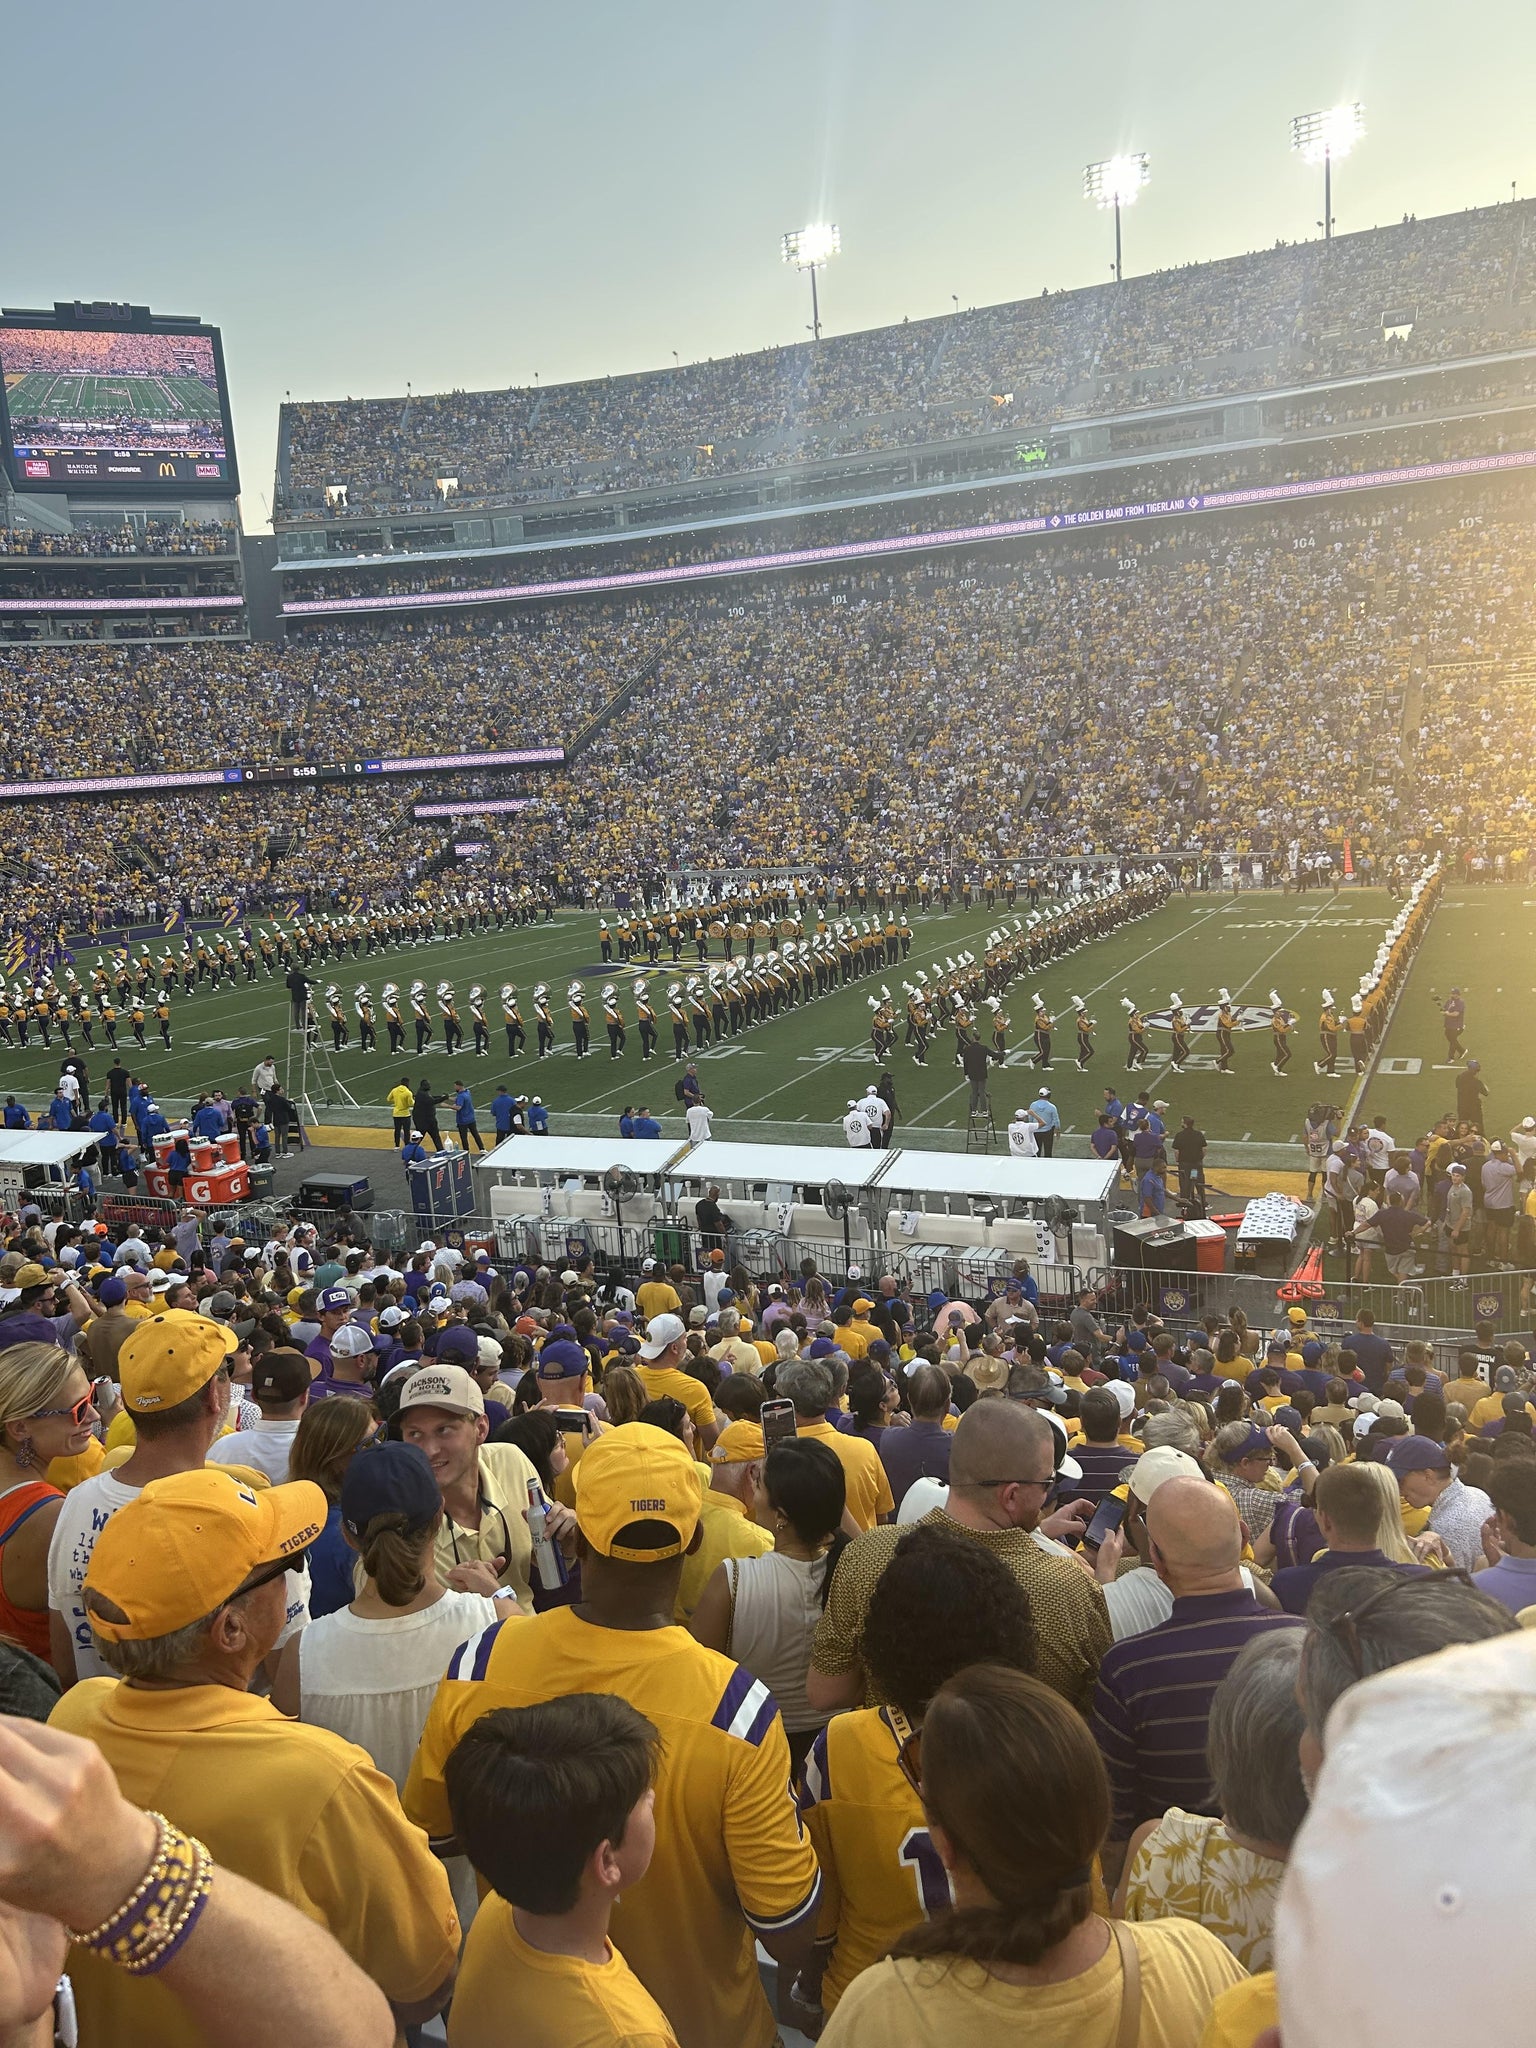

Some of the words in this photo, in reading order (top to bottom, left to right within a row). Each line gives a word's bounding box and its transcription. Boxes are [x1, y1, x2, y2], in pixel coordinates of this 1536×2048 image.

[74, 300, 132, 321] LSU
[1064, 514, 1076, 525] THE
[1078, 510, 1104, 523] GOLDEN
[1105, 507, 1124, 519] BAND
[1125, 504, 1145, 517] FROM
[1146, 499, 1185, 514] TIGERLAND
[1292, 537, 1316, 549] 104
[1117, 558, 1138, 570] 103
[959, 578, 977, 589] 102
[831, 594, 848, 605] 101
[727, 606, 745, 617] 100
[293, 766, 317, 777] 5:58
[341, 766, 346, 774] 1
[354, 763, 362, 772] 0
[245, 771, 253, 779] 0
[1310, 1143, 1323, 1153] 95
[153, 1176, 169, 1196] G
[191, 1180, 211, 1202] G
[230, 1178, 242, 1194] G
[330, 1293, 346, 1301] LSU
[408, 1376, 446, 1394] JACKSON
[135, 1396, 161, 1407] Tigers
[630, 1499, 666, 1512] TIGERS
[279, 1522, 321, 1554] TIGERS
